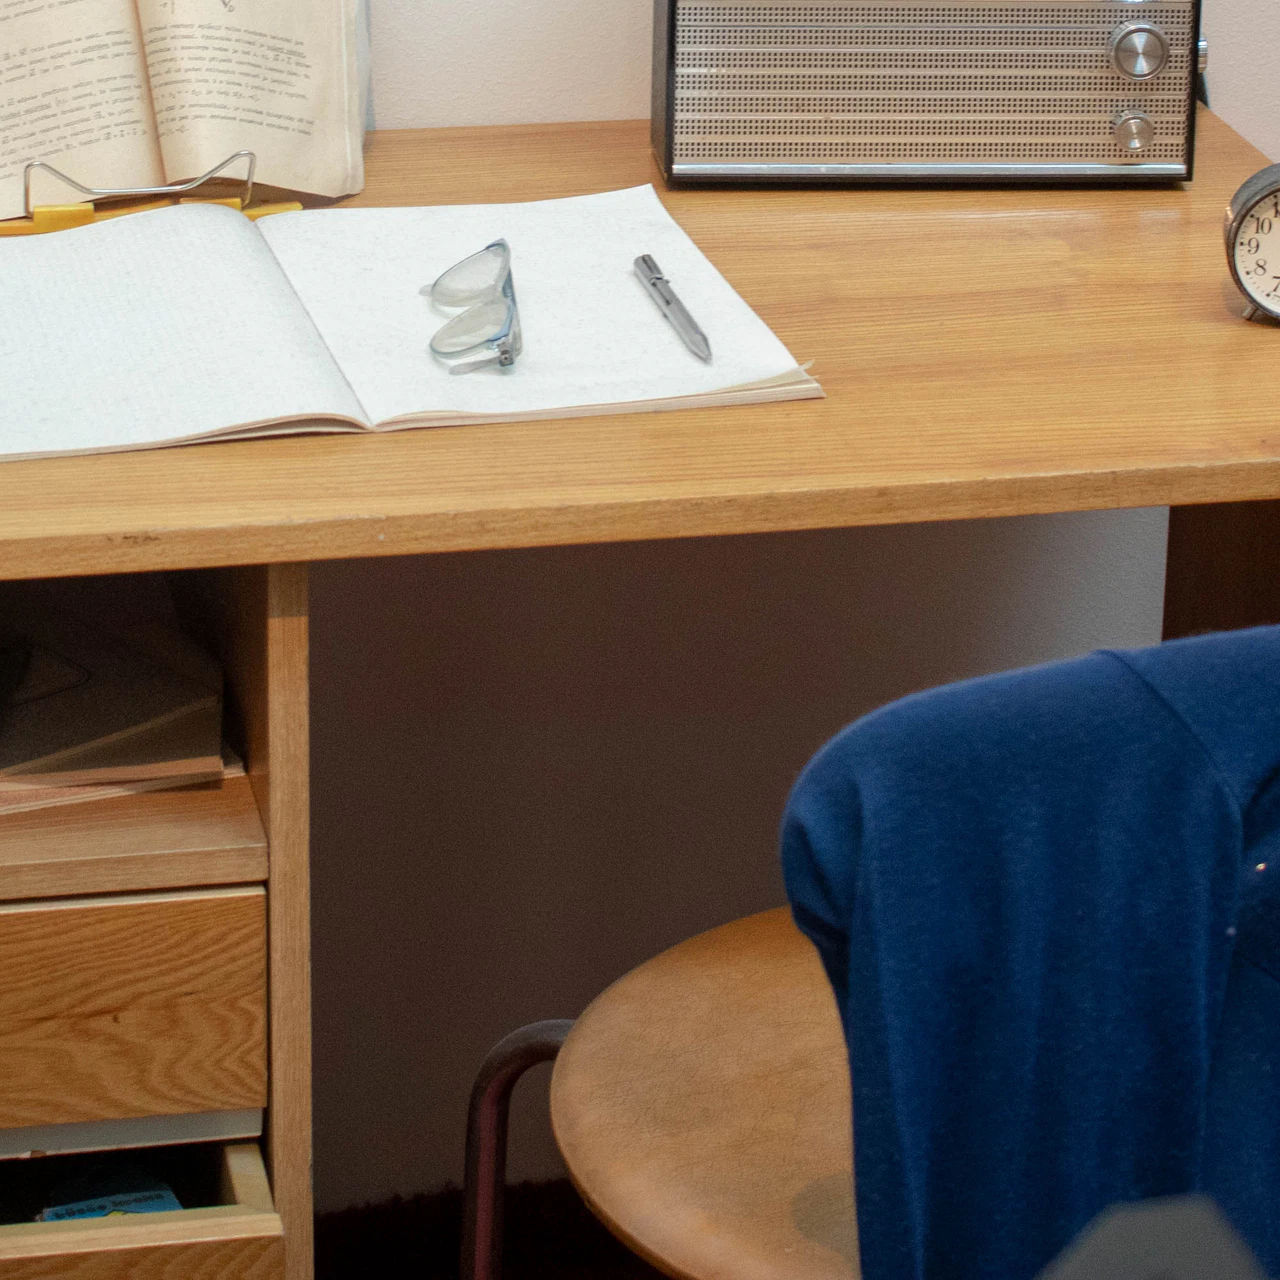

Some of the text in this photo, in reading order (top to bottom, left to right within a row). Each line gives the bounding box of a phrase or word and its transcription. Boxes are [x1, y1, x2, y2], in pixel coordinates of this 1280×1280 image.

[1255, 217, 1272, 235] 10
[1248, 237, 1259, 254] 9
[1254, 259, 1267, 276] 8
